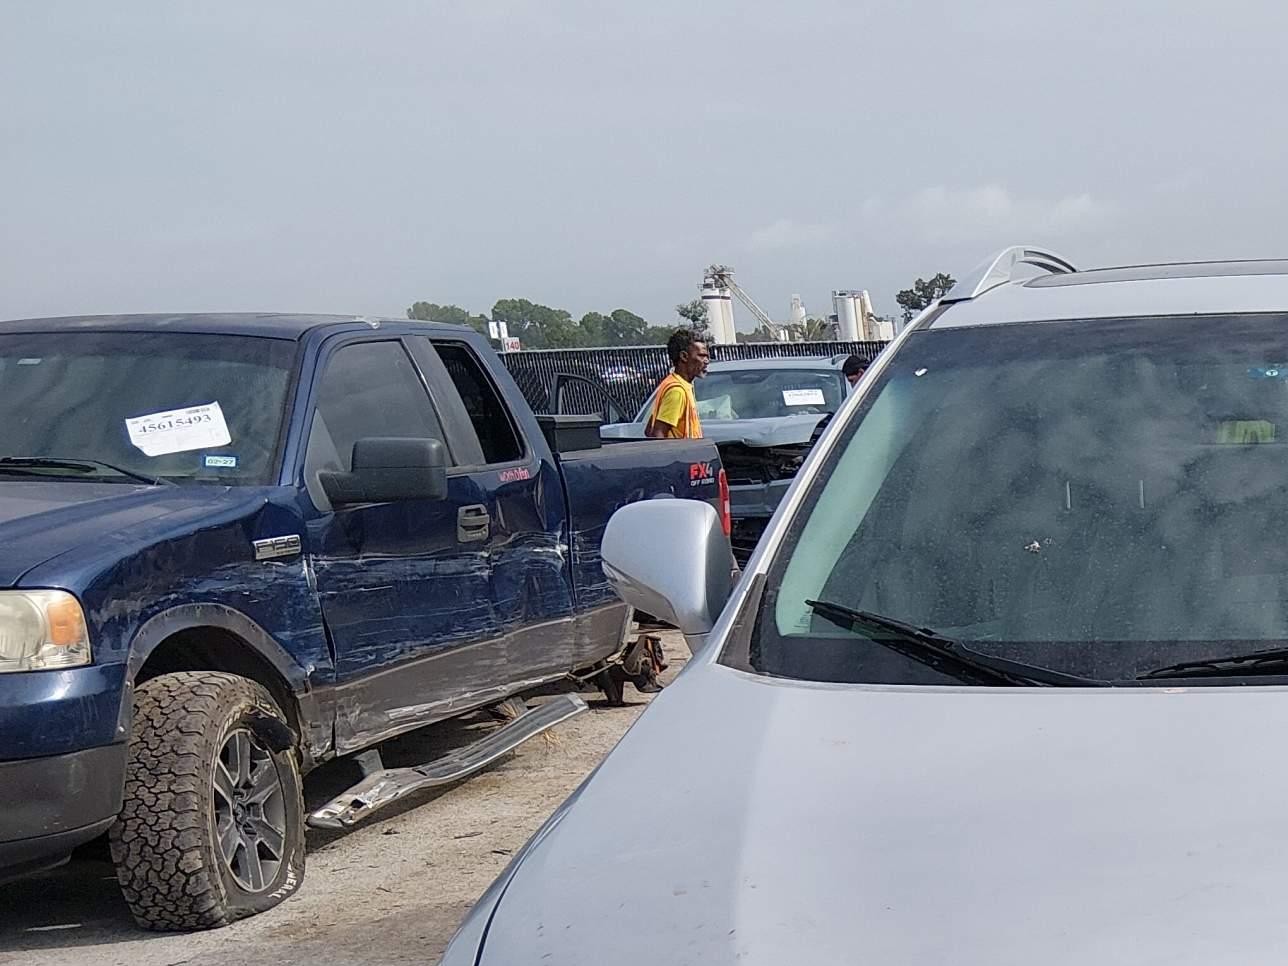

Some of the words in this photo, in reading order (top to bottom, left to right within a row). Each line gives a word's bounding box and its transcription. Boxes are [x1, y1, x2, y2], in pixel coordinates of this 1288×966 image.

[506, 341, 520, 351] 140
[138, 413, 212, 434] 45615493
[690, 462, 713, 480] FX4
